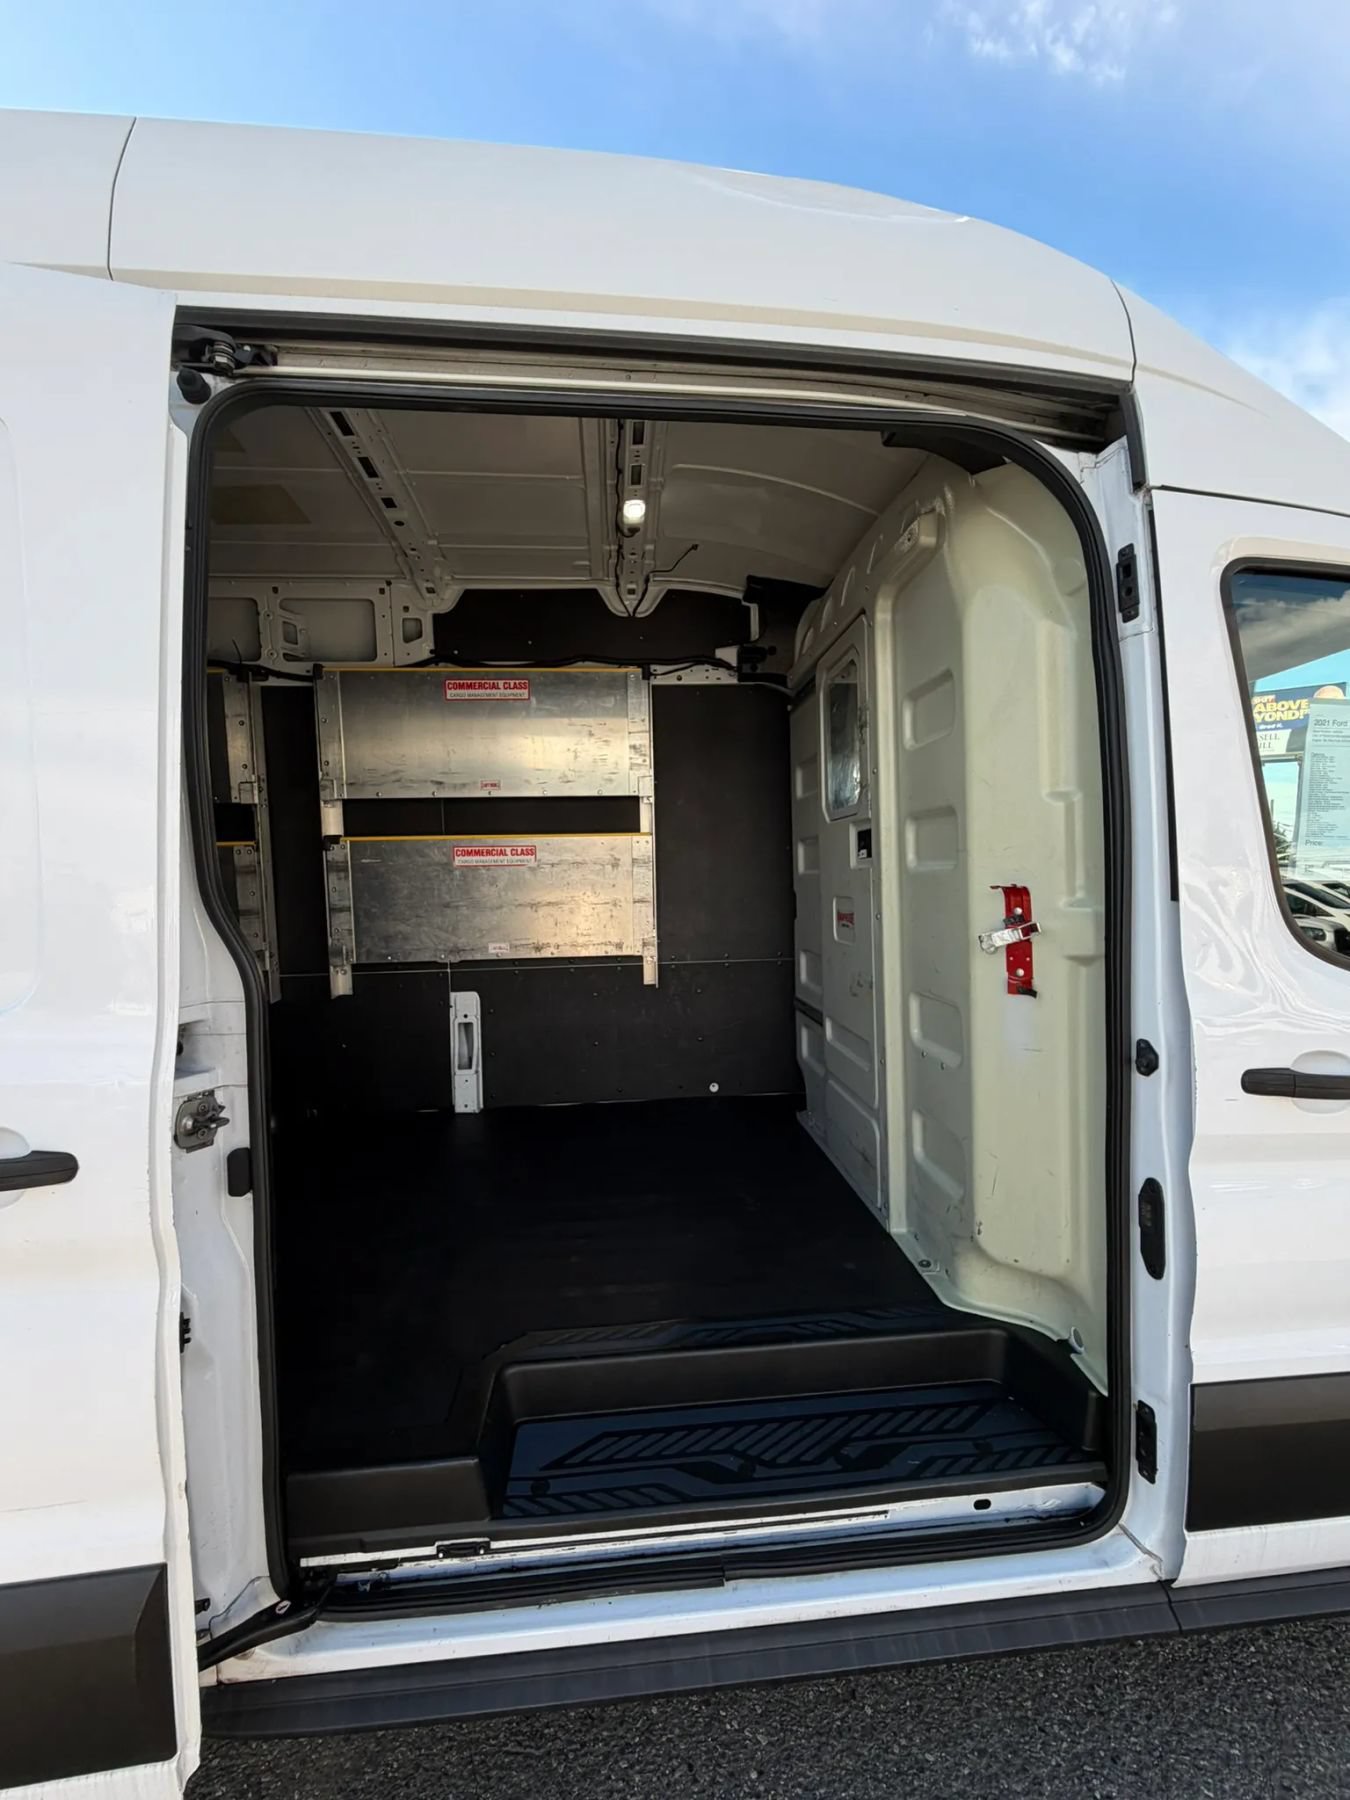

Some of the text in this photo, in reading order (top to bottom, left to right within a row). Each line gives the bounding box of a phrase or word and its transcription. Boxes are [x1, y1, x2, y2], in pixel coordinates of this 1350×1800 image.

[447, 681, 528, 690] COMMERCIAL CLASS
[1254, 699, 1309, 711] ABOVE
[1313, 718, 1348, 727] 2021 Ford
[455, 848, 535, 857] COMMERCIAL CLASS
